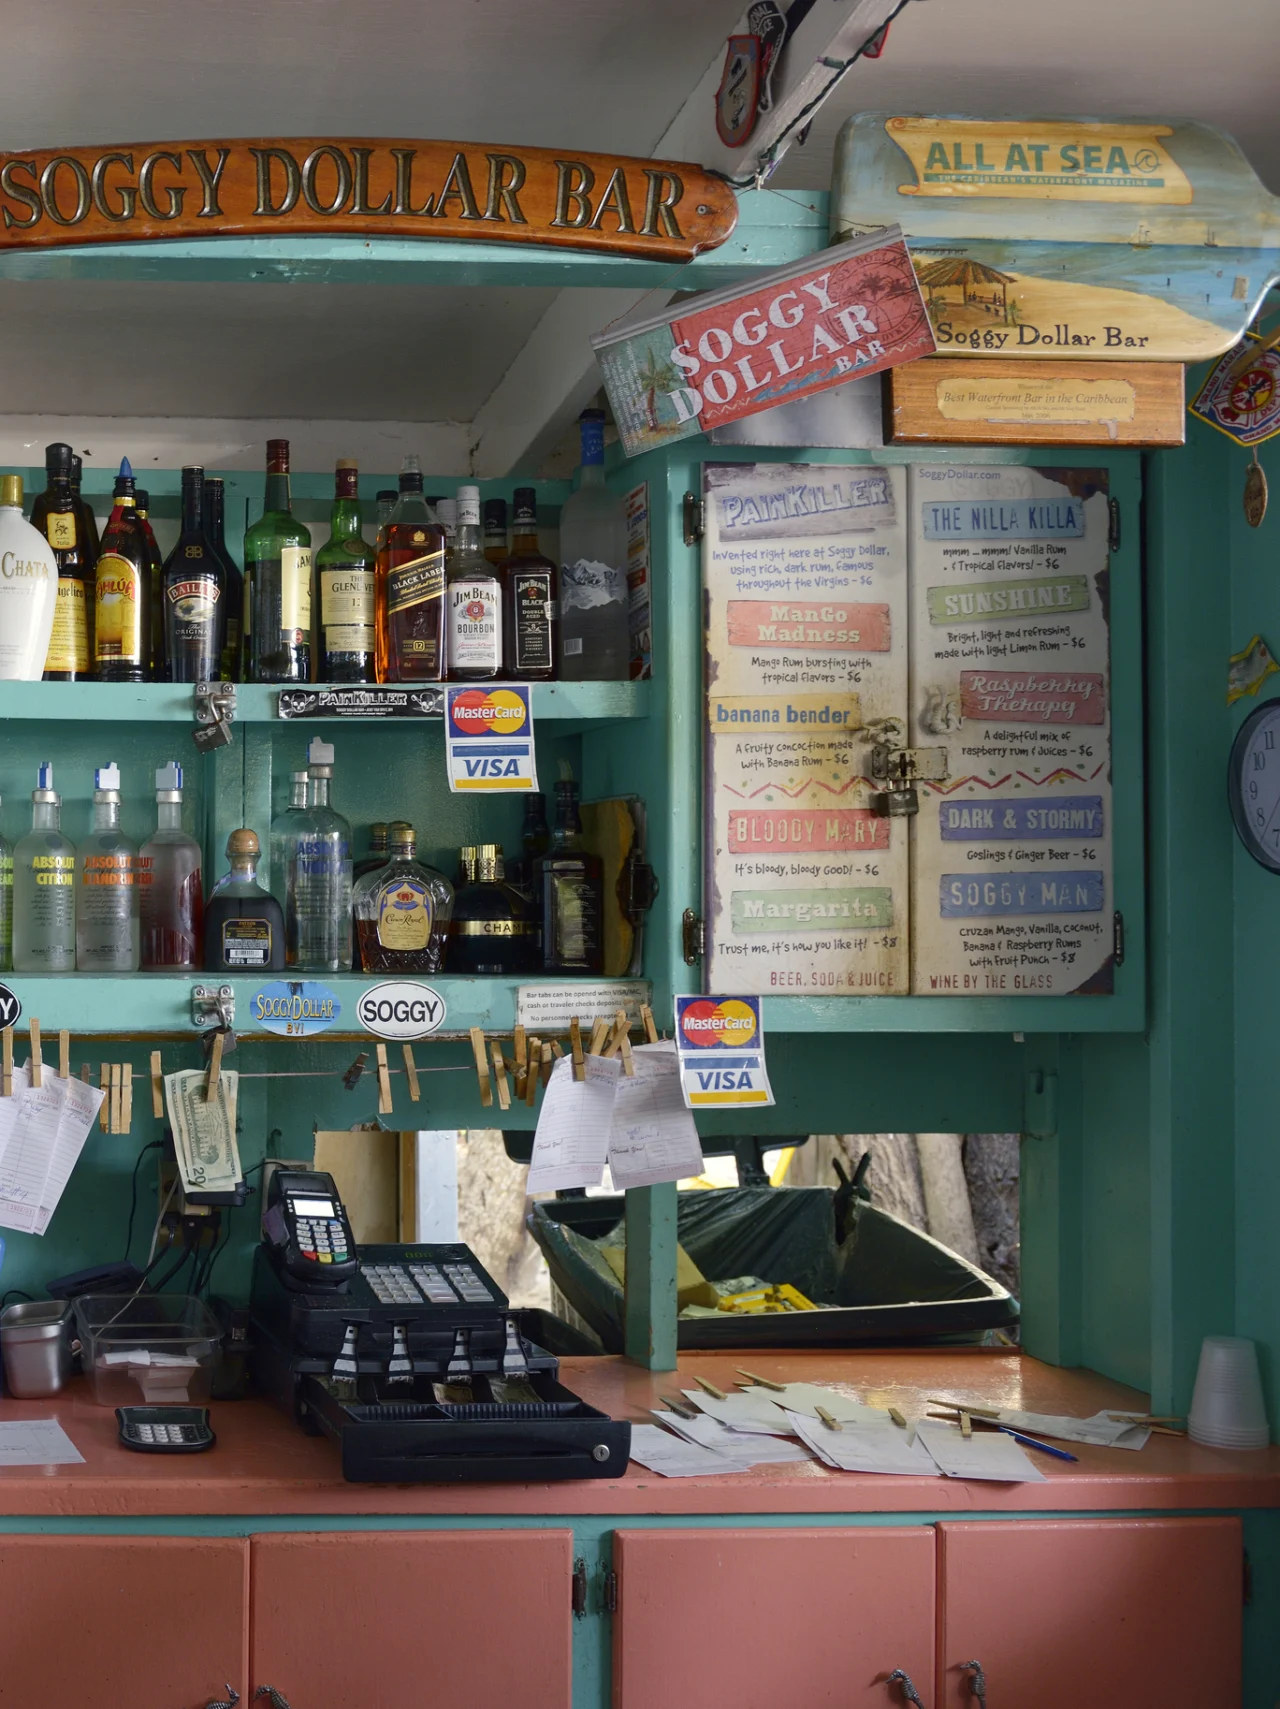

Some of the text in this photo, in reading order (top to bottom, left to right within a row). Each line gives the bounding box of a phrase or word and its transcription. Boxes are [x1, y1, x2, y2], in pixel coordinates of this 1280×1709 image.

[925, 142, 1131, 174] ALL AT SEA
[1030, 176, 1095, 185] WATERFRONT
[1098, 178, 1149, 186] MAGAZINE
[0, 144, 685, 241] SOGGY DOLLAR BAR
[669, 272, 839, 381] SOGGY
[936, 322, 1149, 349] Soggy Dollar Bar
[666, 304, 878, 425] DOLLAR
[836, 339, 886, 374] BAR
[944, 391, 1128, 405] Best Waterfront Bar in the Caribbean
[920, 469, 1001, 482] SoggyDollar.com
[932, 506, 1076, 532] THE NILLA KILLA
[712, 545, 890, 564] Invented right here at Soggy Dollar,
[392, 576, 419, 590] BLACK
[453, 589, 471, 608] JIM
[944, 585, 1072, 616] SUNSHINE
[458, 623, 495, 634] BOURBON
[758, 625, 860, 642] Madness
[948, 625, 1070, 644] Bright, light and refreshing
[970, 676, 1096, 700] Raspberry
[454, 704, 523, 720] MasterCard
[717, 704, 851, 724] banana bender
[977, 696, 1078, 720] Therapy
[1264, 731, 1275, 750] 11
[462, 758, 521, 778] VISA
[1253, 752, 1266, 771] 10
[1250, 781, 1258, 800] 9
[948, 808, 1096, 830] DARK & STORMY
[1256, 807, 1266, 827] 8
[736, 817, 878, 844] BLOODY MARY
[32, 856, 75, 868] ABSOLUT
[85, 856, 132, 869] ABSOLUT
[735, 863, 752, 876] It's
[756, 864, 788, 876] bloody,
[791, 864, 821, 877] bloody
[864, 864, 880, 876] $6
[36, 872, 73, 886] CITRON
[950, 882, 1089, 906] SOGGY MAN
[742, 898, 878, 922] Margarita
[812, 972, 844, 987] SODA
[848, 972, 855, 986] &
[858, 972, 894, 987] JUICE
[930, 974, 1053, 990] WINE BY THE GLASS
[363, 1000, 438, 1022] SOGGY
[286, 1022, 304, 1034] BVI
[683, 1016, 753, 1030] MasterCard
[696, 1071, 753, 1090] VISA
[193, 1167, 206, 1184] 20
